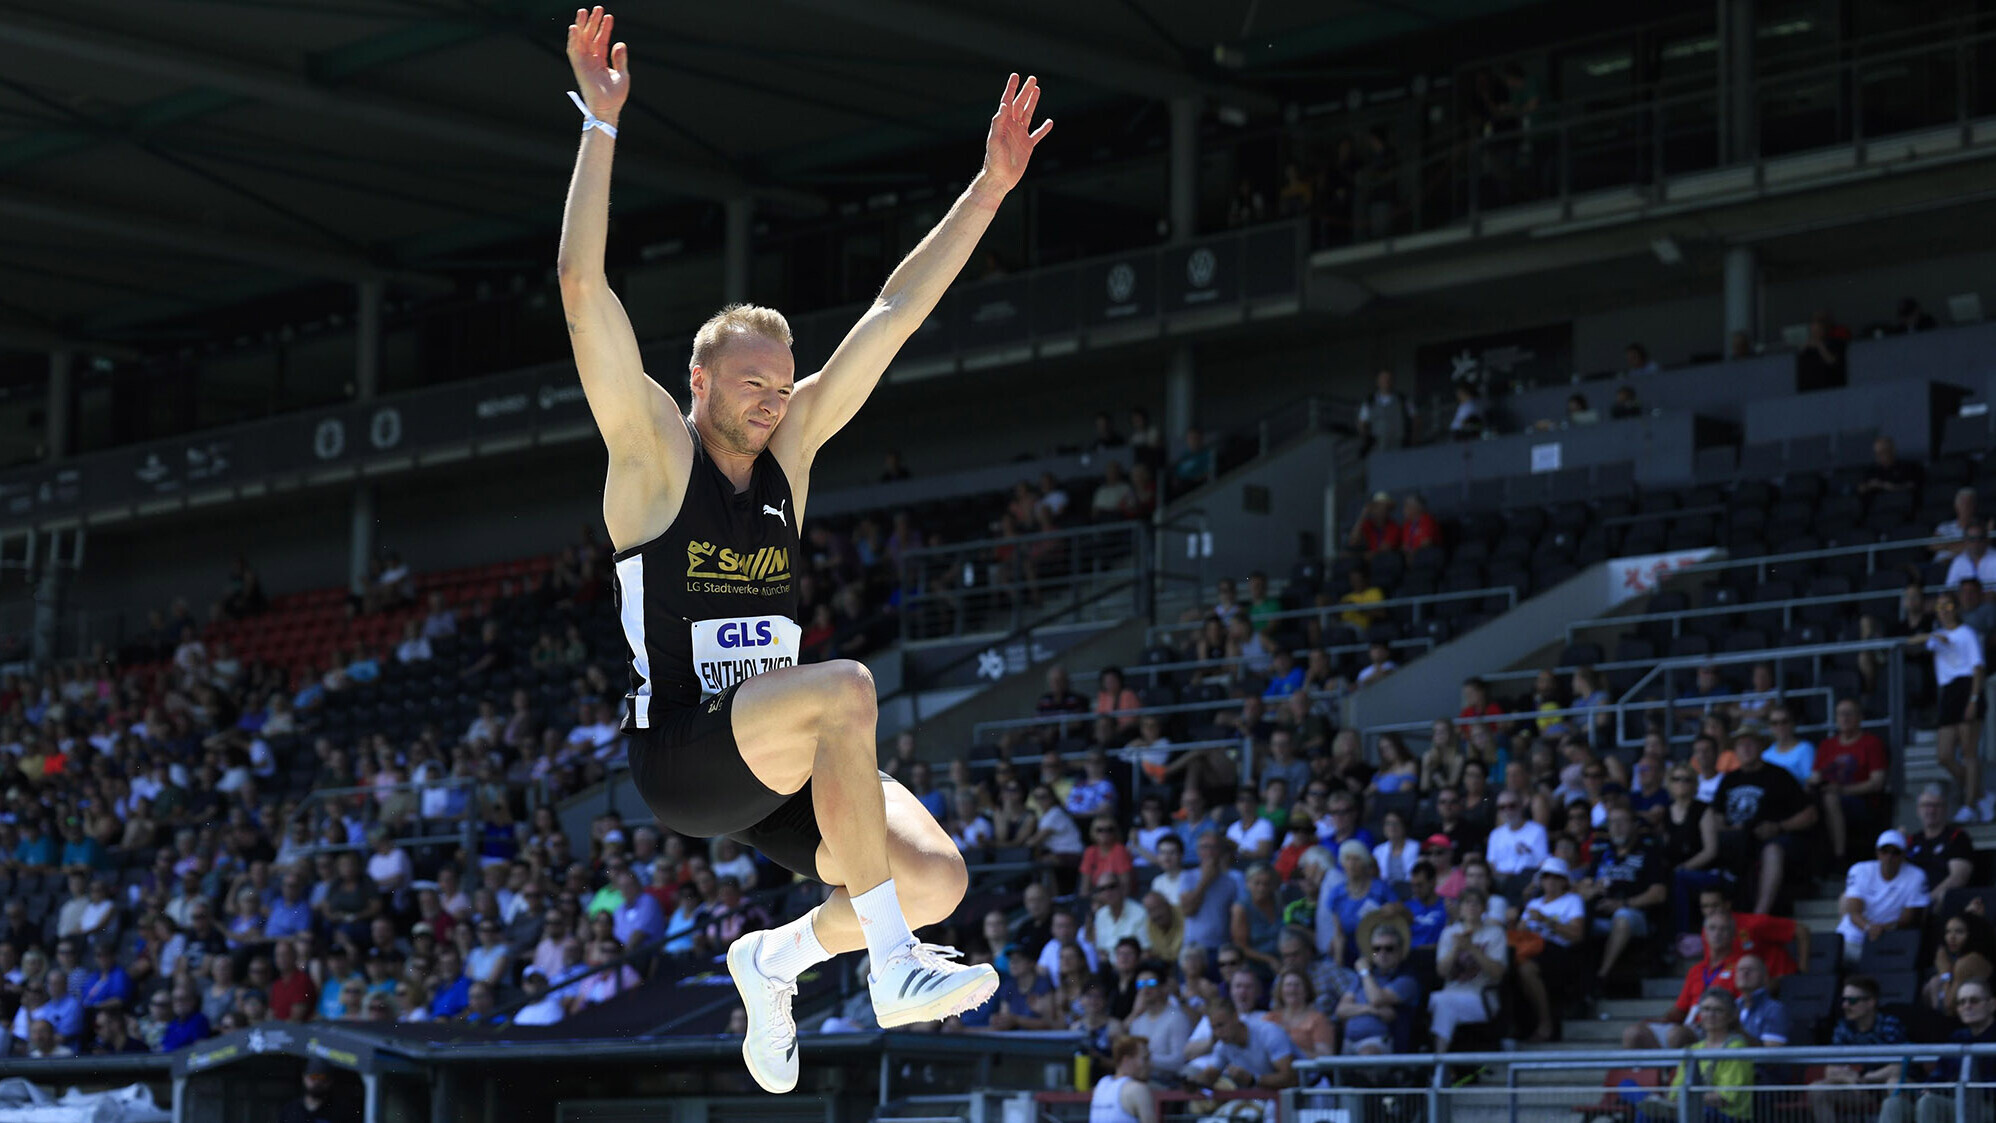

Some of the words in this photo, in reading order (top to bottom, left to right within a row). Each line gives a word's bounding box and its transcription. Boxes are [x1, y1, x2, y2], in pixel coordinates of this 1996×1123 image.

[687, 582, 701, 592] LG
[704, 582, 759, 595] Stadtwerke
[761, 583, 791, 598] Münche
